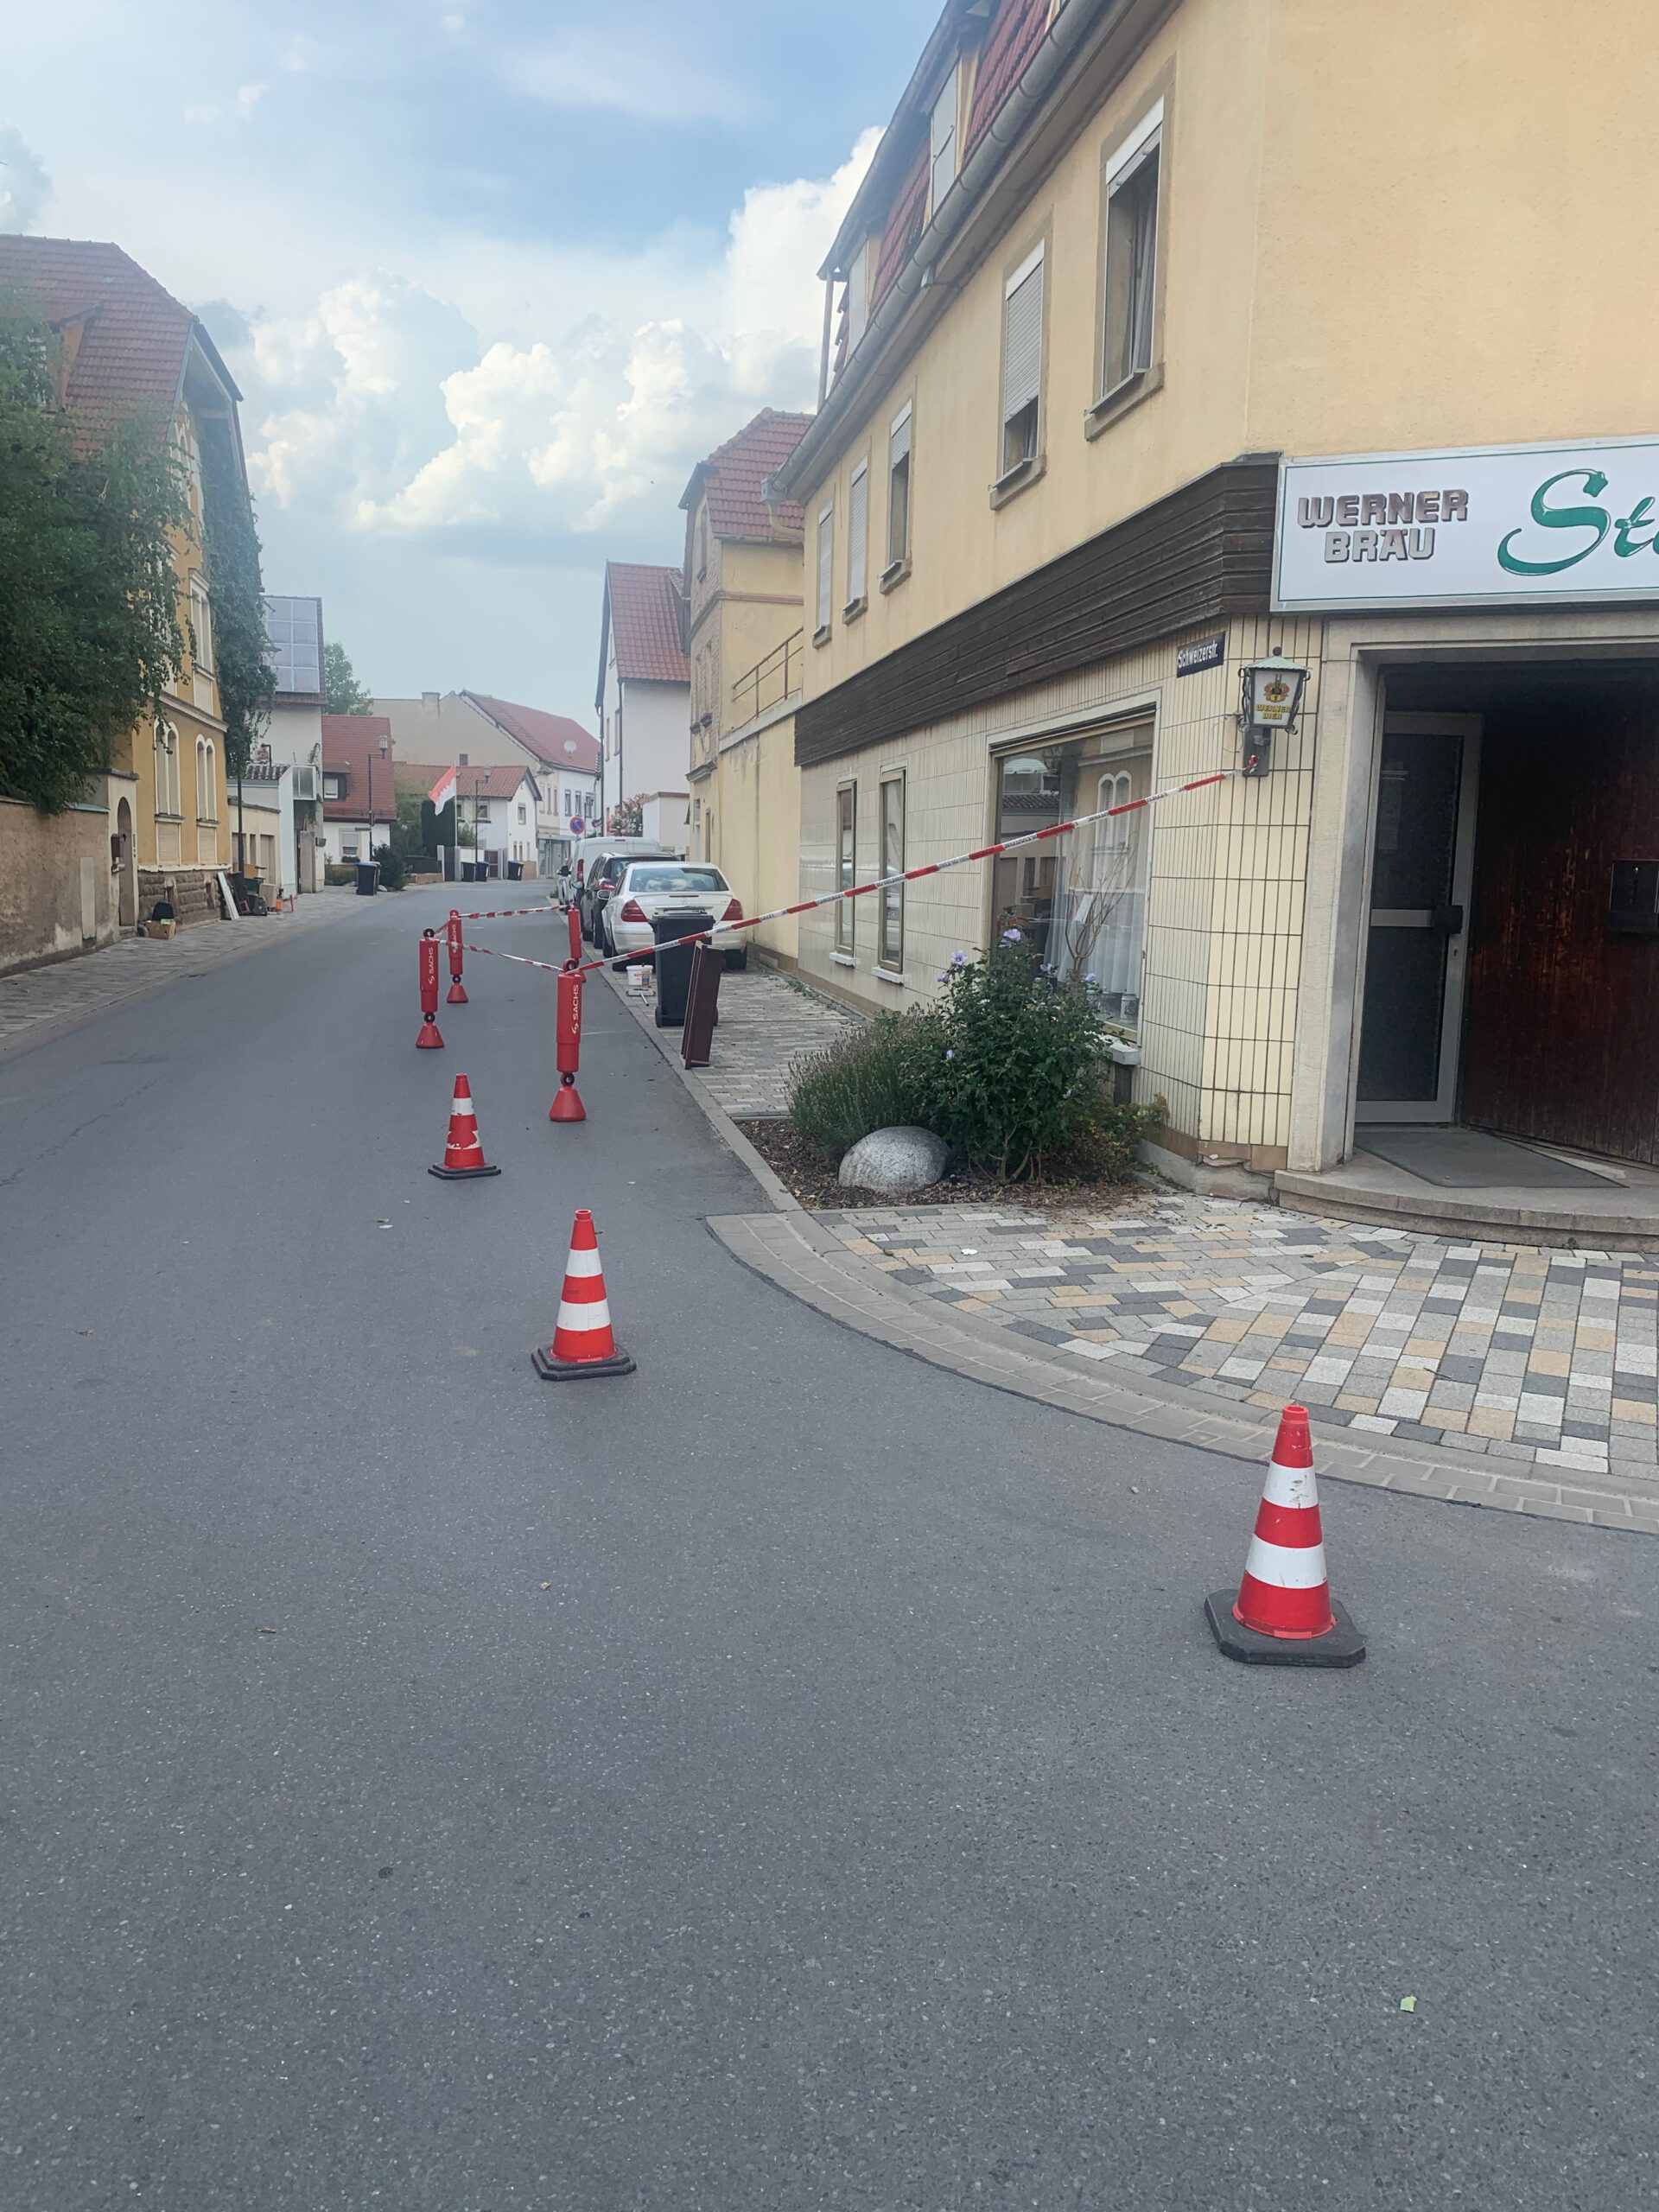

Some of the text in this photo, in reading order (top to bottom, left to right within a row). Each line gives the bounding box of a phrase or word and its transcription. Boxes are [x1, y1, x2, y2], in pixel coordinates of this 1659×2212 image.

[1297, 489, 1469, 528] WERNER
[1497, 468, 1659, 576] St
[1325, 527, 1435, 563] BRÄU
[1178, 639, 1218, 669] Schweizerstr.
[1256, 704, 1293, 714] WERNER
